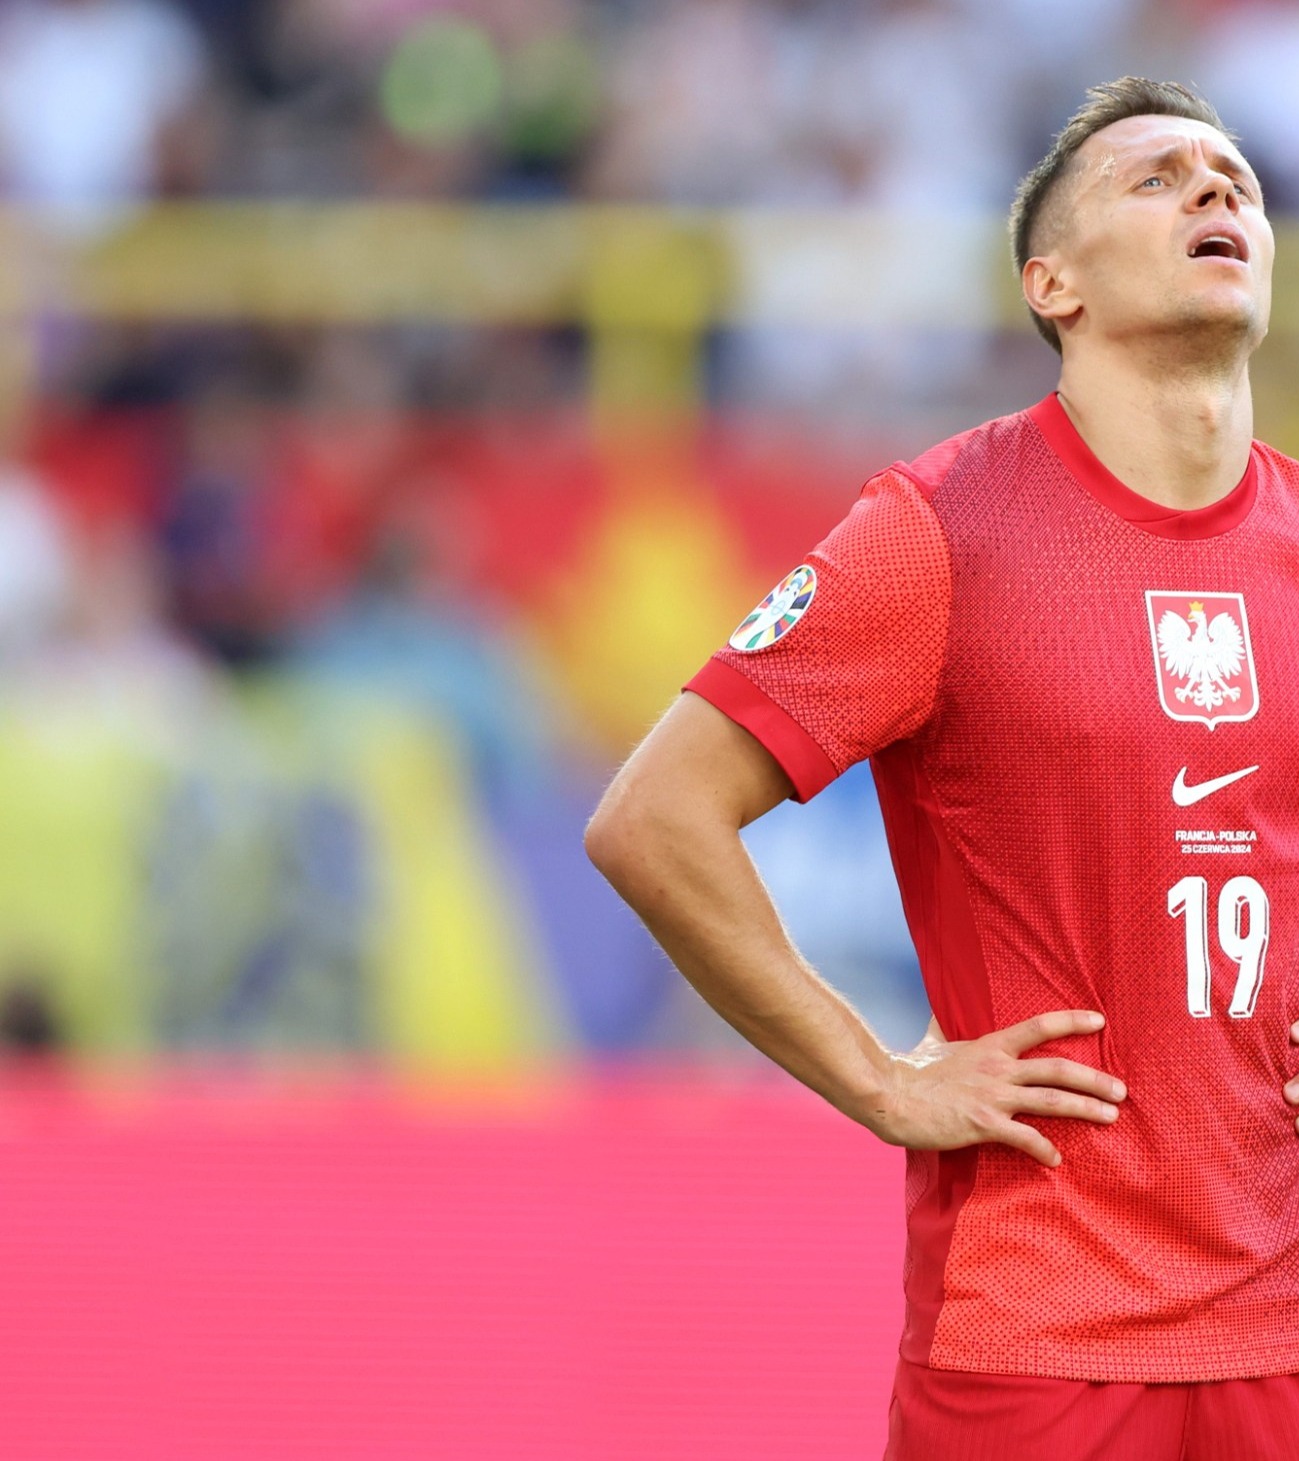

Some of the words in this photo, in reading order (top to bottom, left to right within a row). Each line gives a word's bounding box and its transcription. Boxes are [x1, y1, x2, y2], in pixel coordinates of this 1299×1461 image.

[1181, 844, 1192, 854] 25
[1192, 844, 1230, 854] CZERWCA
[1230, 844, 1251, 854] 2024
[1167, 875, 1270, 1018] 19
